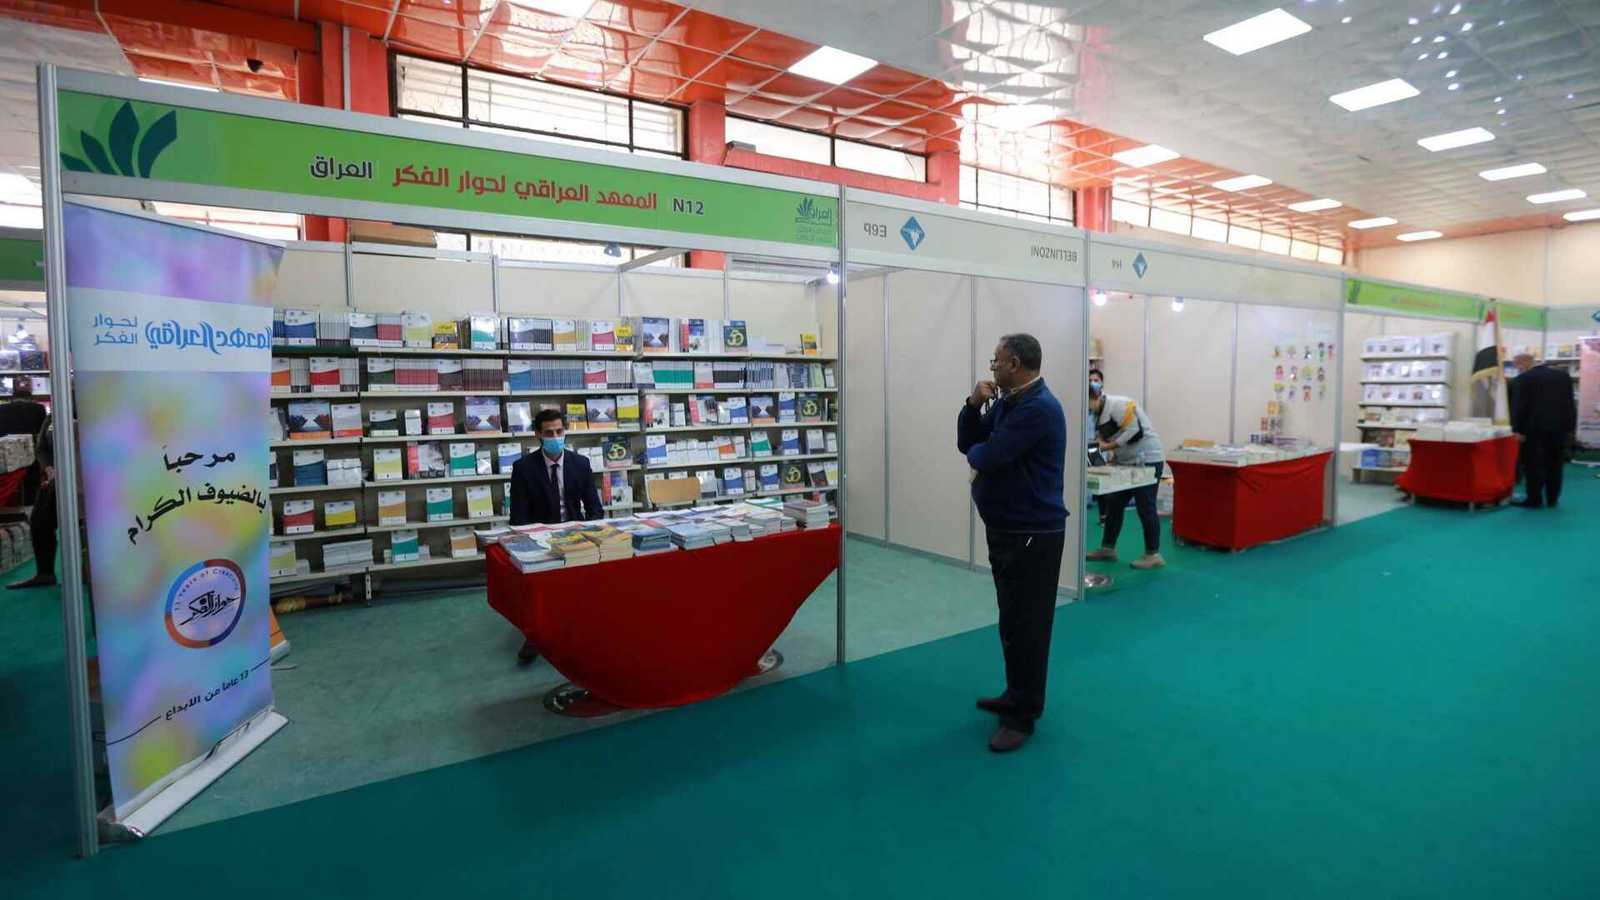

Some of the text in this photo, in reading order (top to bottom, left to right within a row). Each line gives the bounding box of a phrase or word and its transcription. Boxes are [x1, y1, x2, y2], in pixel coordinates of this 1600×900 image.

[310, 155, 705, 216] N12 المعهد العراقي لحوار الفكر العراق
[1029, 244, 1079, 264] BELLINZONI
[92, 313, 139, 328] لحوار
[94, 332, 139, 346] الفكر
[144, 319, 223, 356] العراقي
[127, 482, 267, 545] بالضيوف الكرام
[203, 687, 221, 702] من
